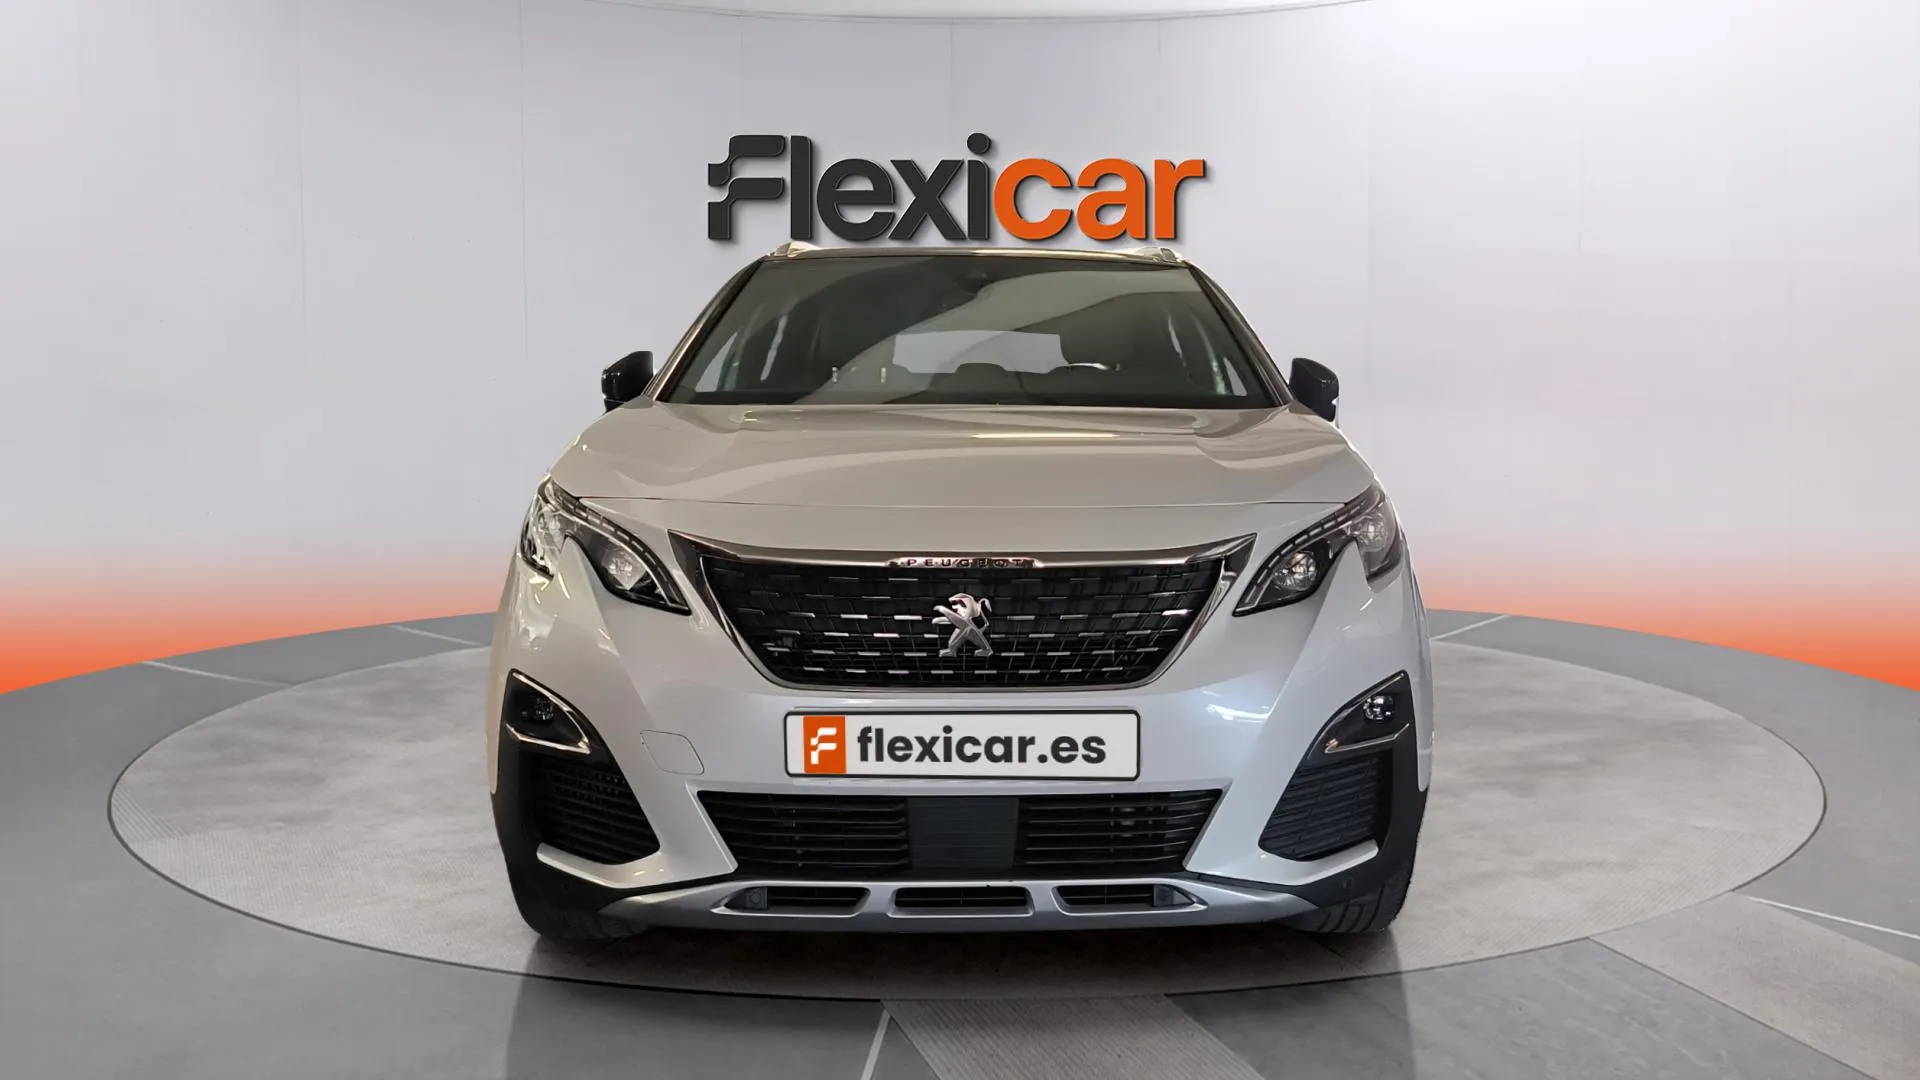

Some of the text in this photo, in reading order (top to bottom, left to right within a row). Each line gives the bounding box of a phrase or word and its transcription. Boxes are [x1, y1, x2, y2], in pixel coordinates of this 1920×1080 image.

[708, 133, 1207, 244] Flexicar
[906, 558, 1024, 568] PEUGEOT
[857, 725, 1106, 764] flexicar.es
